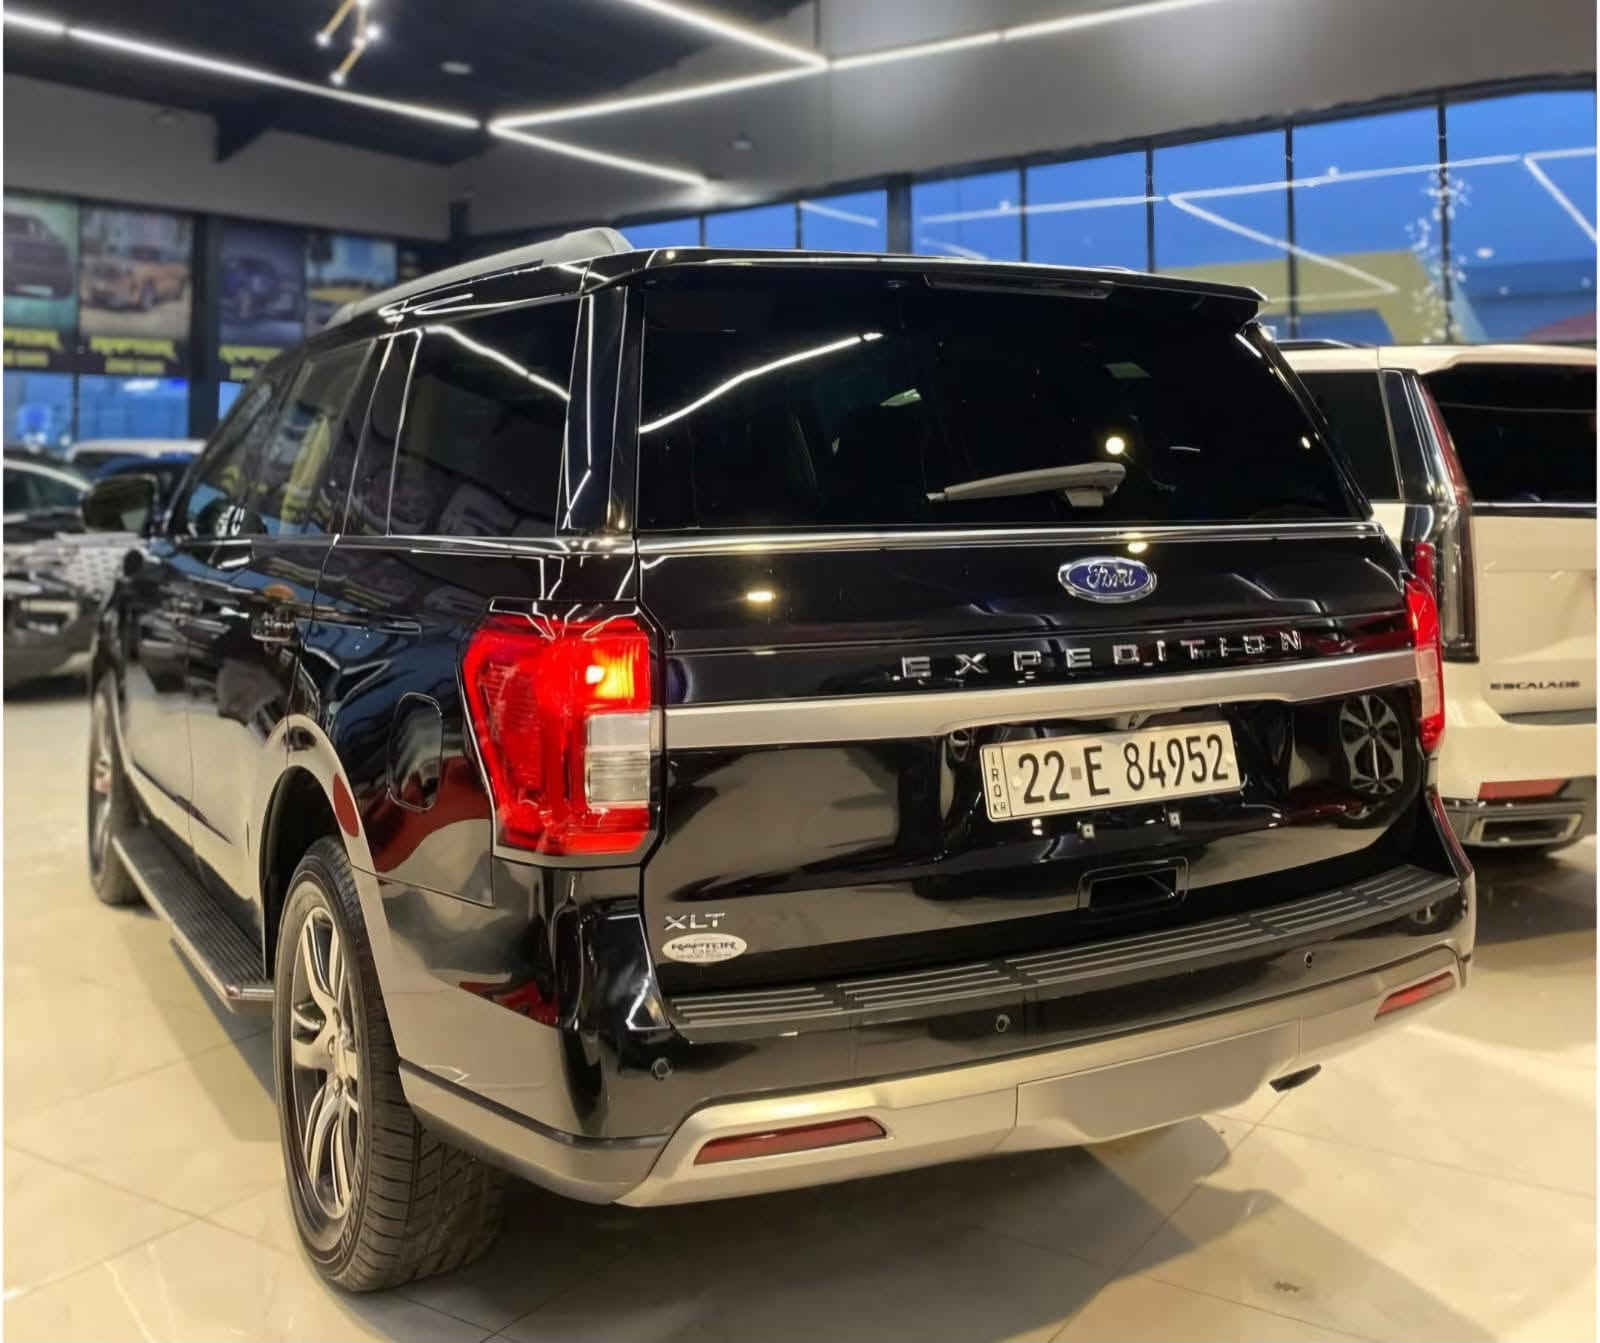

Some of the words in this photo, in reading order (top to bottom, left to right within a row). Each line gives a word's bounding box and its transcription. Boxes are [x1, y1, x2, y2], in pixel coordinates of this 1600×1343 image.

[1086, 564, 1137, 589] Ford
[901, 629, 1303, 679] EXPEDITION
[1017, 750, 1070, 805] 22
[1083, 745, 1111, 797] E
[1123, 733, 1229, 792] 84952
[664, 912, 726, 932] XLT
